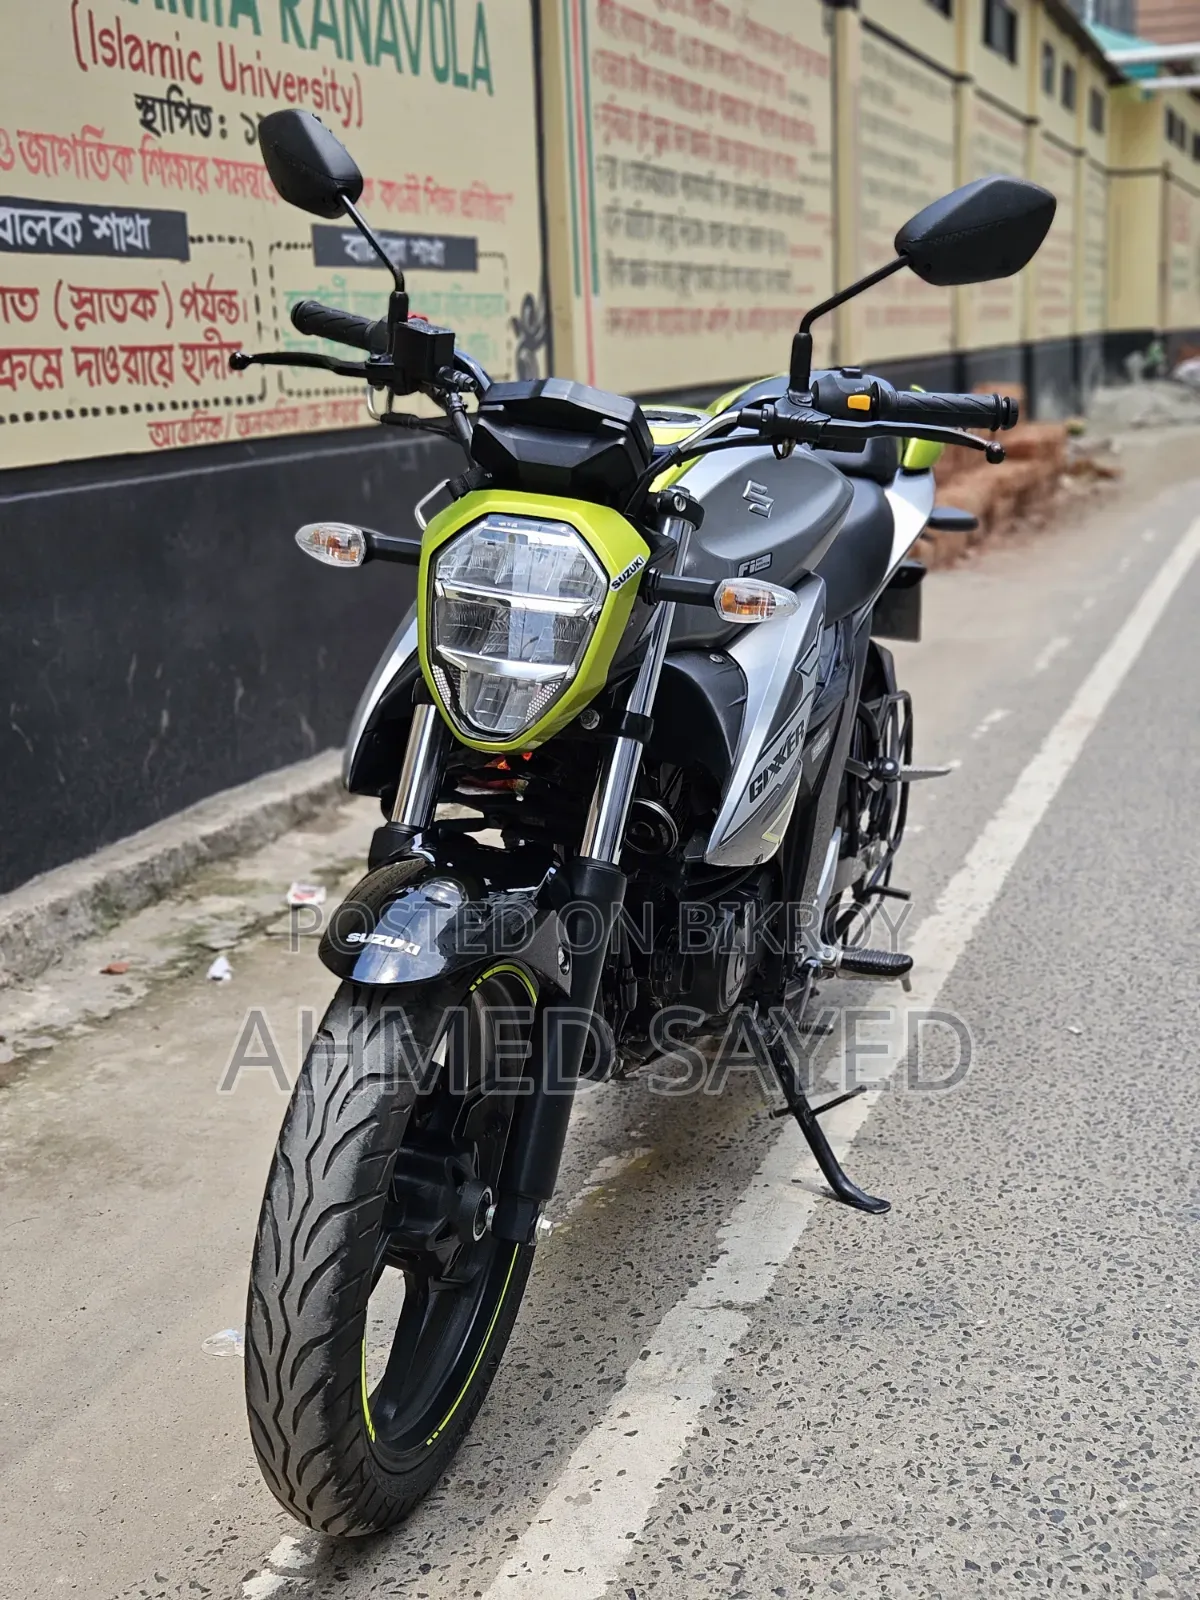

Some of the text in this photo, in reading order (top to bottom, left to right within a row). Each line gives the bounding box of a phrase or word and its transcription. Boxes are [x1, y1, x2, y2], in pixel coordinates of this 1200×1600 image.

[71, 0, 204, 85] (Islamic
[217, 41, 363, 129] University)
[88, 211, 151, 252] শাখা
[610, 556, 645, 590] SUZUKI
[346, 932, 421, 956] SUZUKI
